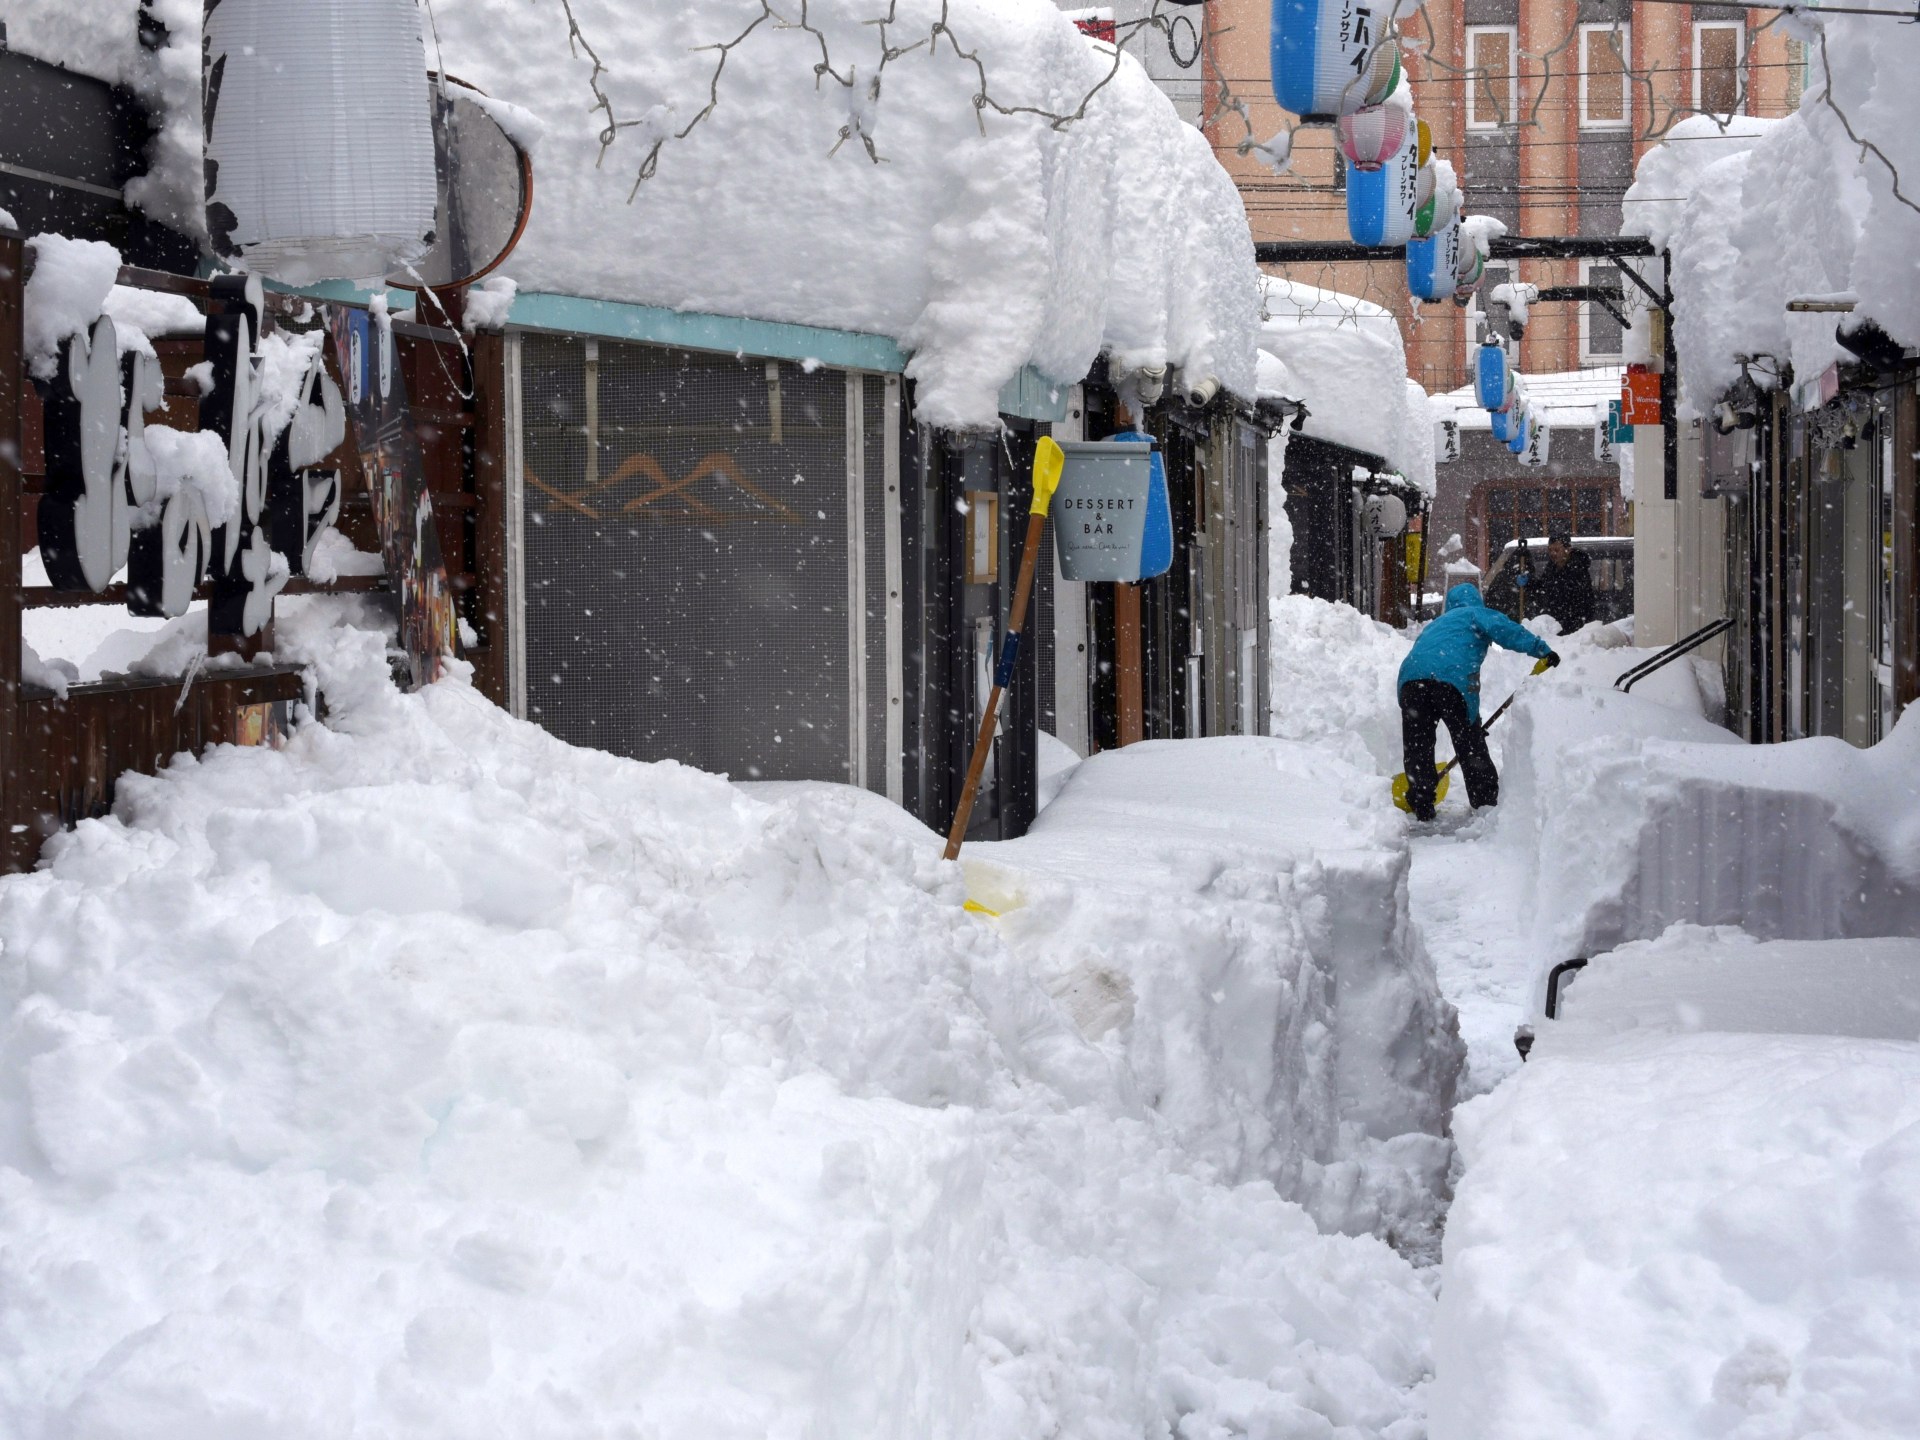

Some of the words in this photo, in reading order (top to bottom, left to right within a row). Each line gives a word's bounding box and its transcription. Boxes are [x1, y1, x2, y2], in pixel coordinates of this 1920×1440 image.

[1400, 155, 1408, 206] プレーンサワー
[1407, 144, 1418, 220] タコハイ
[1450, 223, 1460, 280] タコハイ
[1064, 498, 1134, 510] DESSERT
[1095, 513, 1102, 521] &
[1084, 523, 1113, 534] BAR
